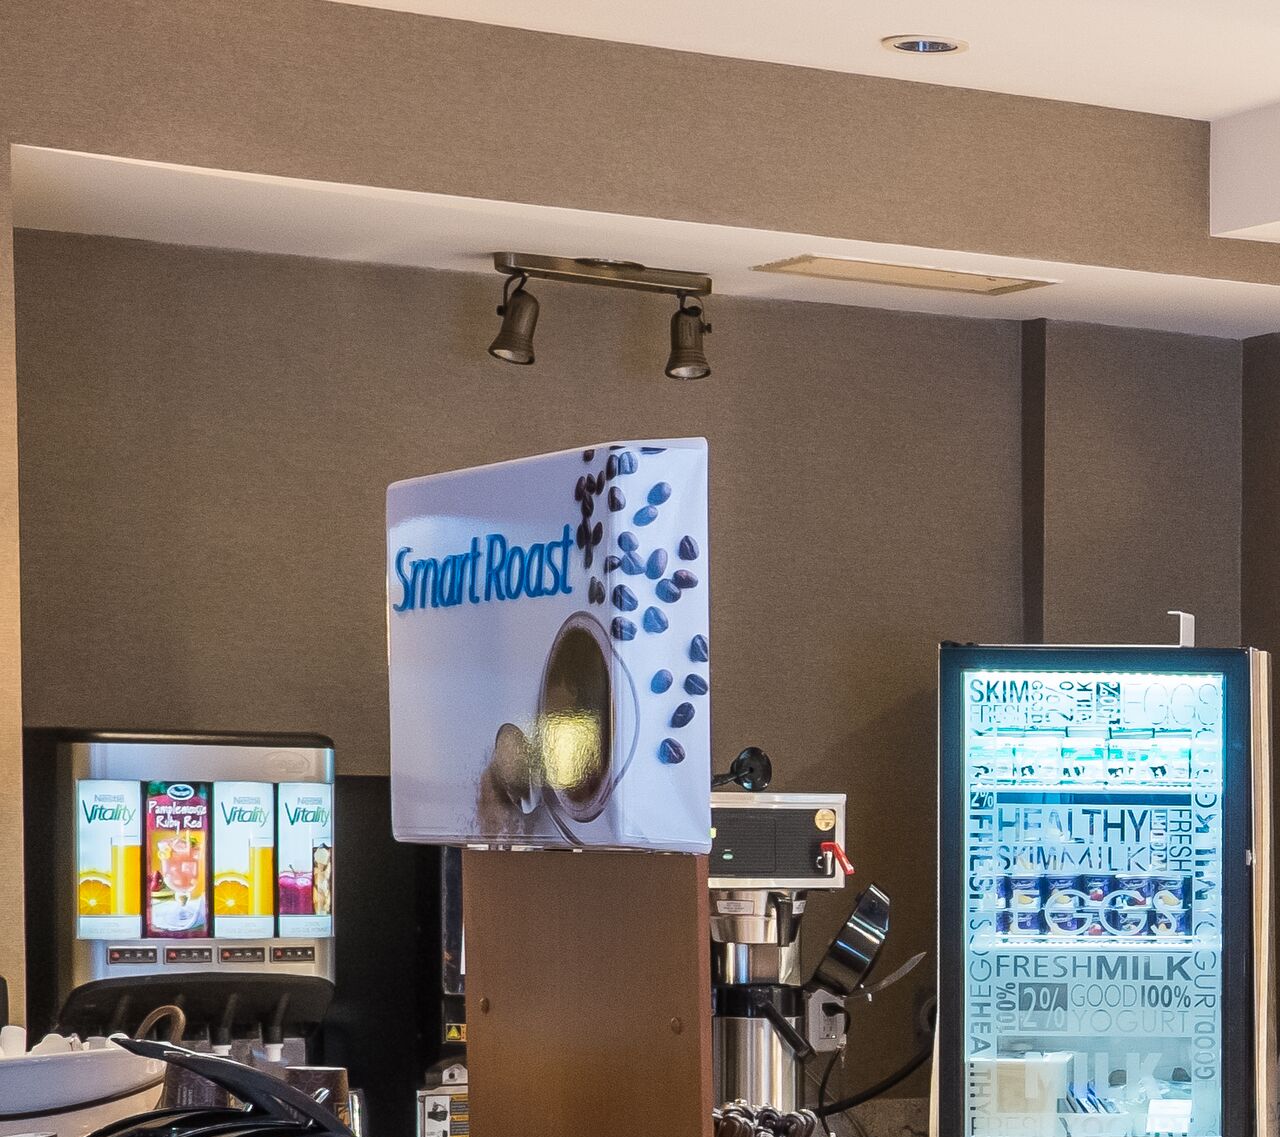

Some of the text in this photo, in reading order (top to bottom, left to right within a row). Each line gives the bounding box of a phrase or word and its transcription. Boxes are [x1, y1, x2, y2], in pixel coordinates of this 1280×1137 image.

[393, 524, 573, 613] Smart Roast
[970, 679, 1029, 703] SKIM
[1123, 682, 1220, 726] EGGS
[82, 800, 137, 826] Vitality
[156, 815, 203, 833] Ruby Red
[220, 801, 271, 828] Vitality
[284, 801, 331, 827] Vitality
[997, 808, 1149, 844] HEALTHY
[1169, 808, 1193, 872] FRESH
[1010, 889, 1181, 937] EGGS
[995, 955, 1194, 981] FRESH MILK
[996, 981, 1017, 1034] 100%
[1019, 985, 1068, 1032] 2%
[1070, 983, 1192, 1009] GOOD 100%
[1071, 1009, 1192, 1033] YOGURT
[969, 1001, 994, 1114] HEATHY
[1193, 1021, 1217, 1080] GOOD
